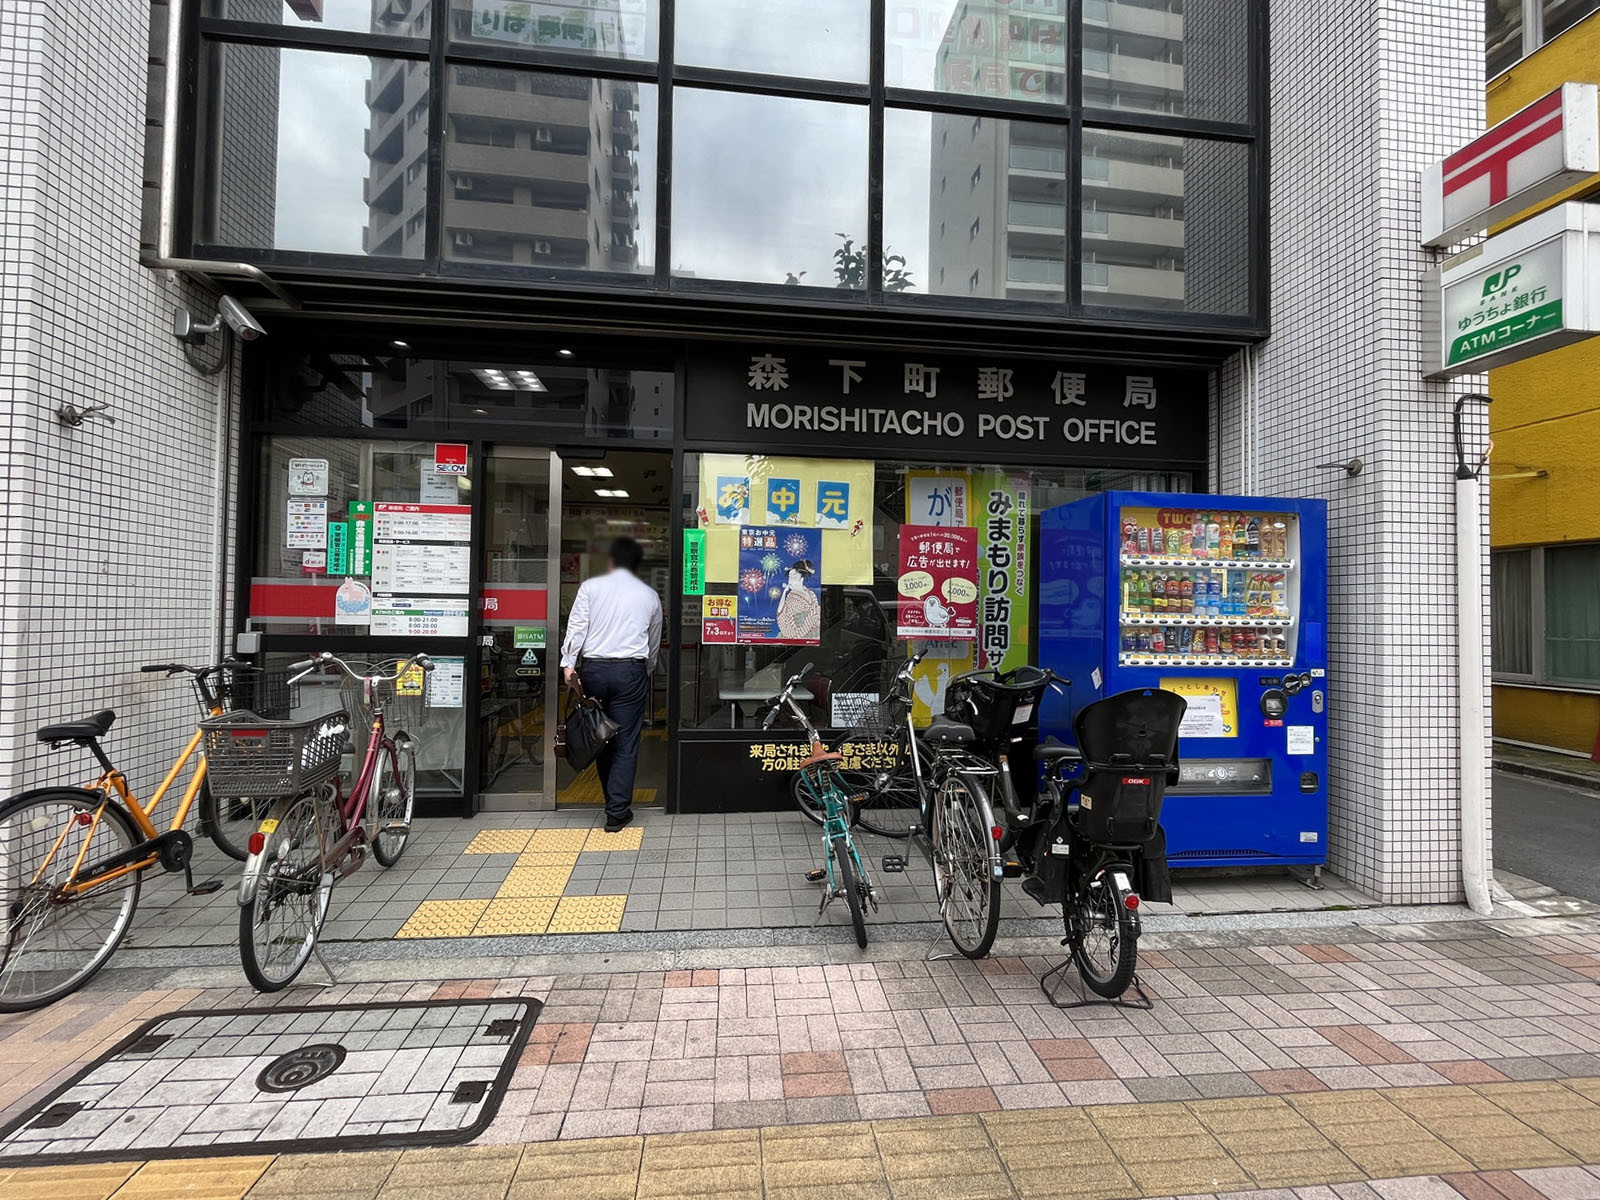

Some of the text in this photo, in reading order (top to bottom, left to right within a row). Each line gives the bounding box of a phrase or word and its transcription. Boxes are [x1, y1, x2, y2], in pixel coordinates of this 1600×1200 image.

[1480, 286, 1518, 306] BANK
[1458, 285, 1548, 332] ゆうちょ銀行
[1460, 312, 1557, 353] ATMコーナー
[747, 354, 1157, 411] 森下町郵便局
[746, 403, 1157, 446] MORISHITACHO POST OFFICE
[436, 464, 465, 472] SECOM
[718, 477, 848, 515] お中元
[741, 528, 776, 537] 東京お中元
[741, 537, 776, 548] 特選品
[918, 541, 961, 555] 郵便局で
[707, 598, 732, 608] お得な
[711, 607, 729, 617] 早割
